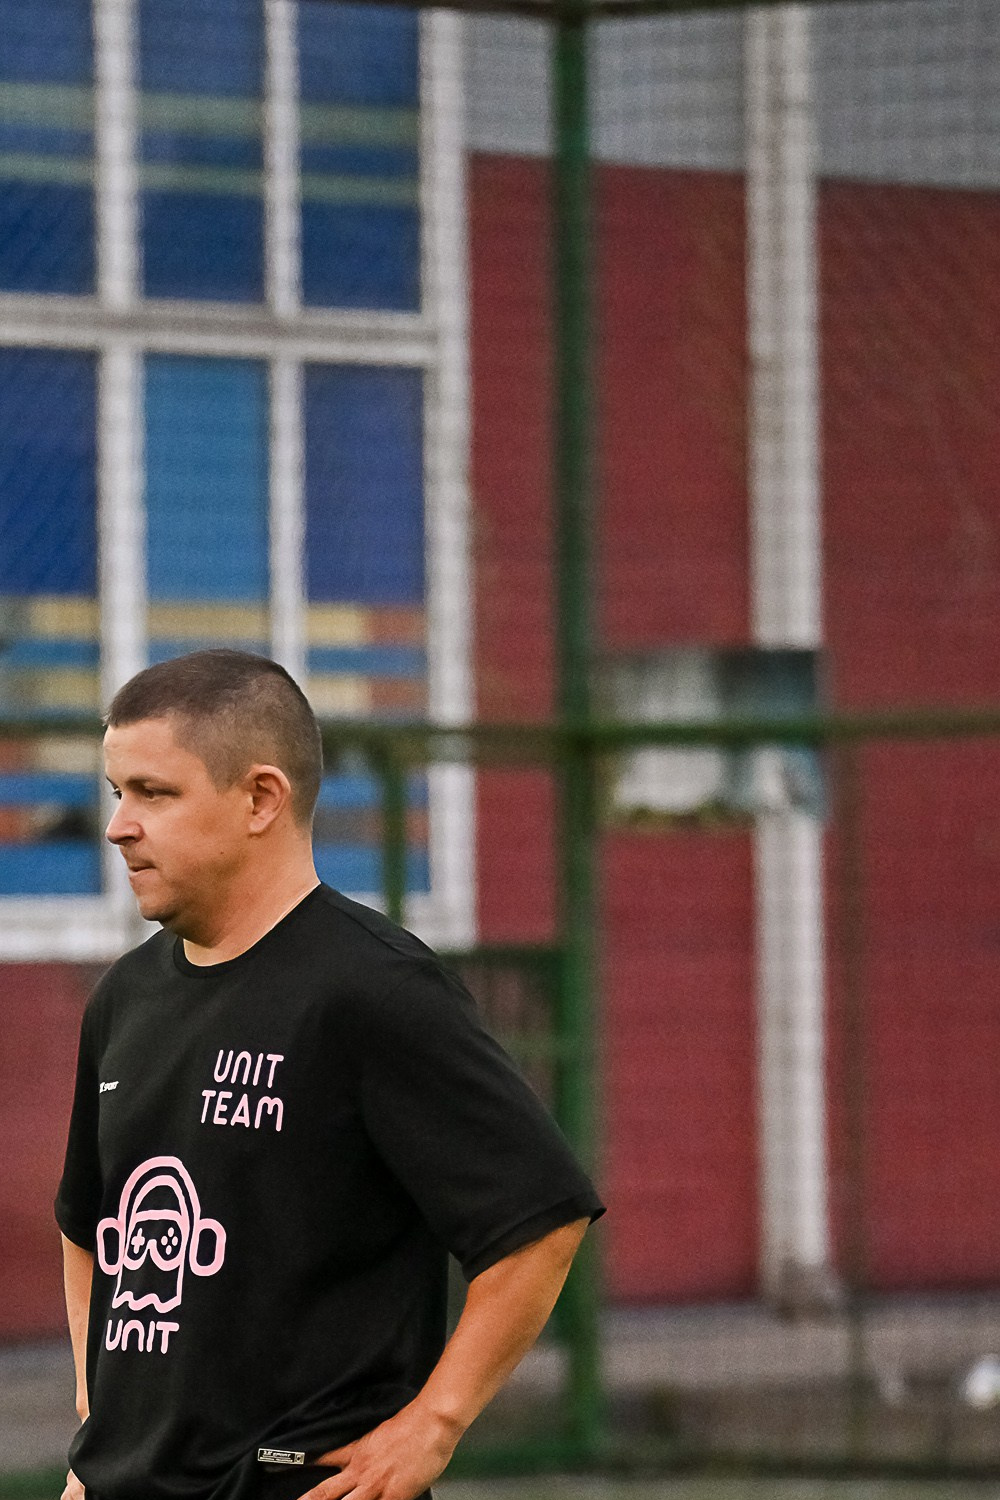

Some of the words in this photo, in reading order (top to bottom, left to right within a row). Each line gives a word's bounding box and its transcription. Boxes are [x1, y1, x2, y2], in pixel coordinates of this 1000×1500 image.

[213, 1049, 285, 1089] UNIT
[200, 1089, 284, 1132] TEAM
[105, 1319, 180, 1355] UNIT
